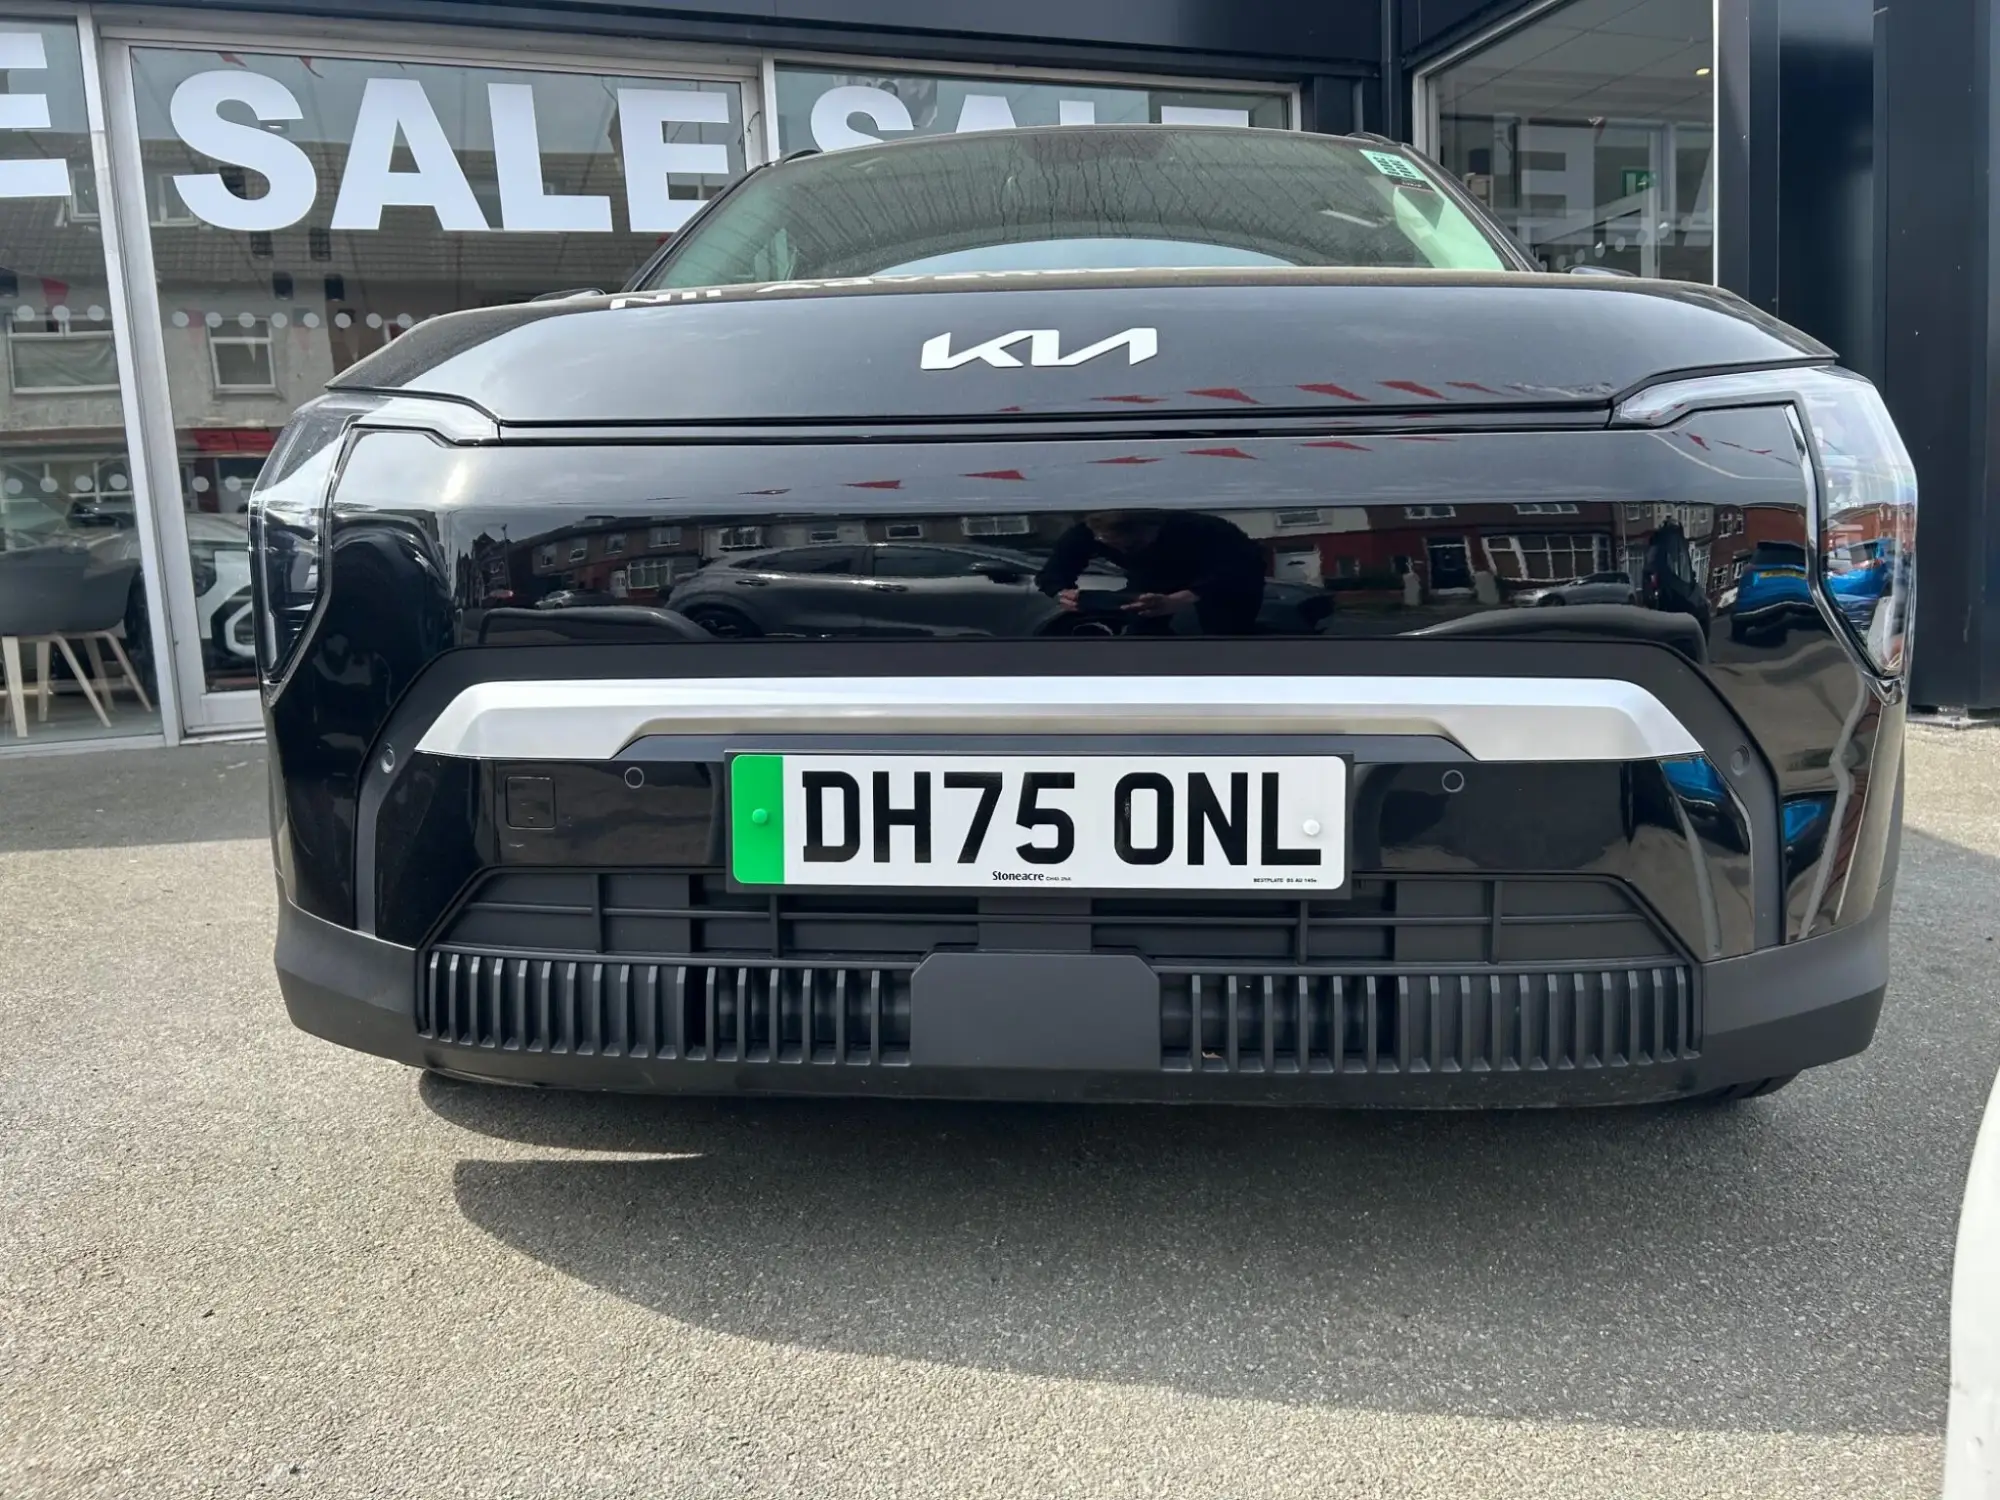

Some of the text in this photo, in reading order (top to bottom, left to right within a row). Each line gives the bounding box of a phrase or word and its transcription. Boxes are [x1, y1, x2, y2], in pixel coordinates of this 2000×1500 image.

[170, 69, 731, 232] SALE
[802, 771, 1321, 866] DH75 ONL
[992, 870, 1045, 881] Stoneacre
